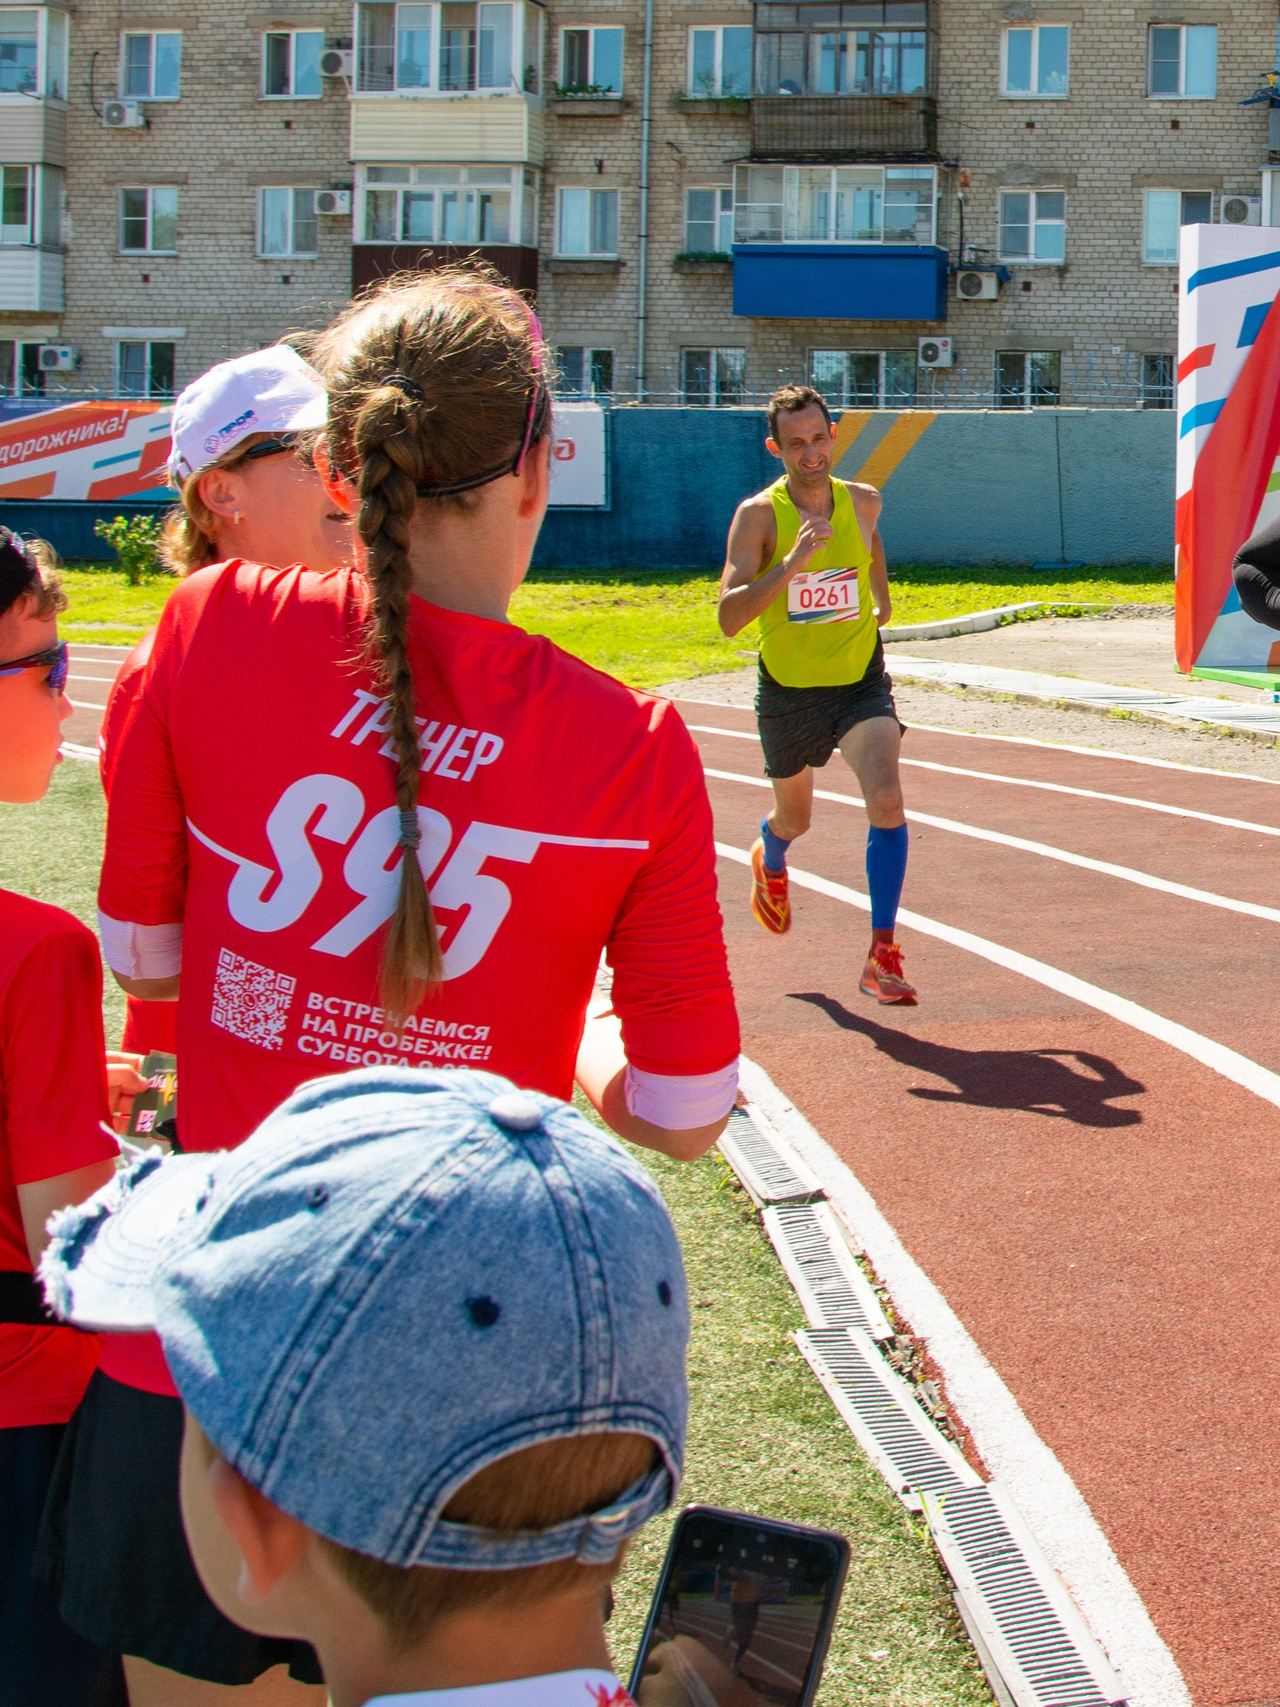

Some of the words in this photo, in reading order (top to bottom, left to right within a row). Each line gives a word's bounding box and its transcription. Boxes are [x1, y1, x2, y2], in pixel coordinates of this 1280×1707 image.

[800, 584, 848, 609] 0261
[227, 773, 541, 982] S95
[301, 1014, 338, 1037] НА
[343, 1023, 492, 1061] ПРОБЕЖКЕ!
